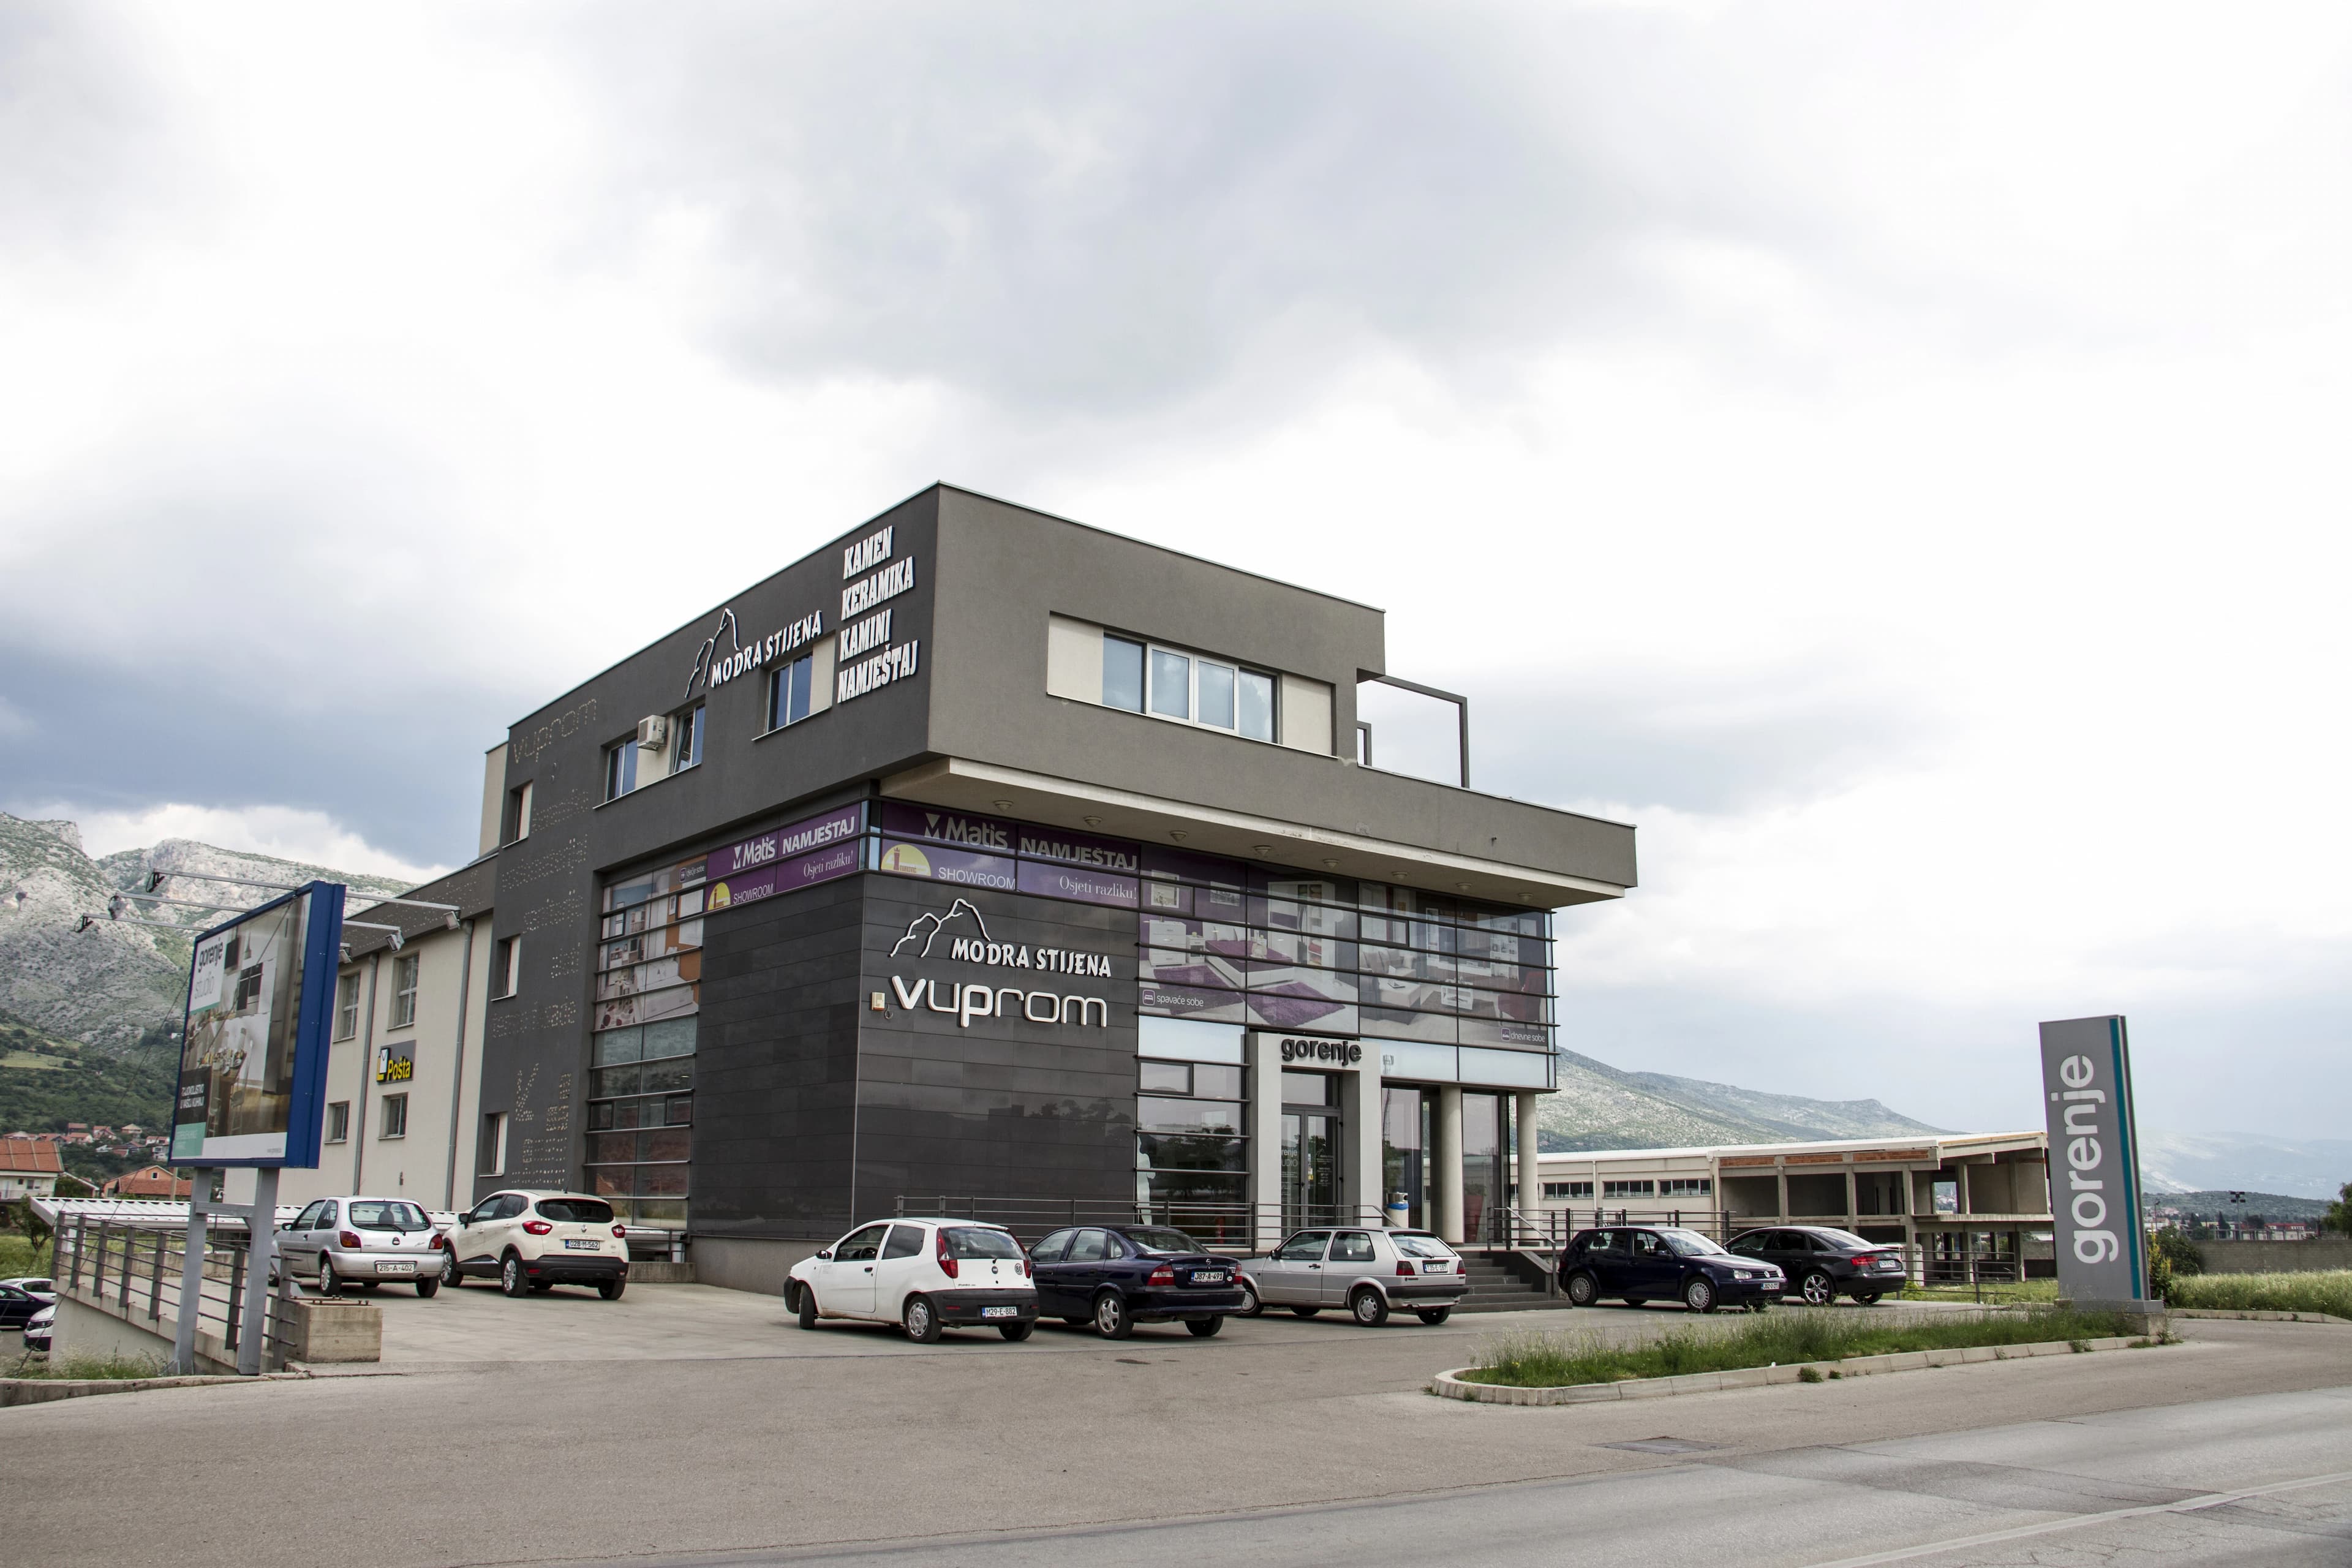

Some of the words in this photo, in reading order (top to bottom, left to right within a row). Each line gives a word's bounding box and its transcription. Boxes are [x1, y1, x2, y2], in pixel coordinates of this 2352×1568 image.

[843, 526, 894, 579] KAMEN
[841, 556, 914, 620] KERAMIKA
[711, 641, 761, 688] MODRA
[765, 610, 823, 661] STIJENA
[840, 608, 892, 662] KAMINI
[837, 639, 919, 704] NAMJEŠTAJ
[742, 835, 775, 867] Matis
[782, 816, 855, 854] NAMJEŠTAJ
[944, 816, 1008, 850] Matis
[1020, 837, 1137, 872] NAMJEŠTAJ
[804, 859, 824, 880] Osjeti
[825, 850, 854, 872] razliku!
[938, 867, 1016, 889] SHOWROOM
[1060, 875, 1092, 897] Osjeti
[1095, 882, 1137, 900] razliku!
[733, 883, 774, 904] SHOWROOM
[198, 937, 223, 973] gorenje
[951, 938, 1030, 968] MODRA
[1036, 949, 1111, 978] STIJENA
[892, 975, 1107, 1027] vuprom
[1156, 995, 1185, 1005] spavaće
[1186, 998, 1204, 1006] sobe
[1281, 1038, 1362, 1066] gorenje
[1510, 1031, 1531, 1041] dnevne
[2051, 1054, 2119, 1264] gorenje
